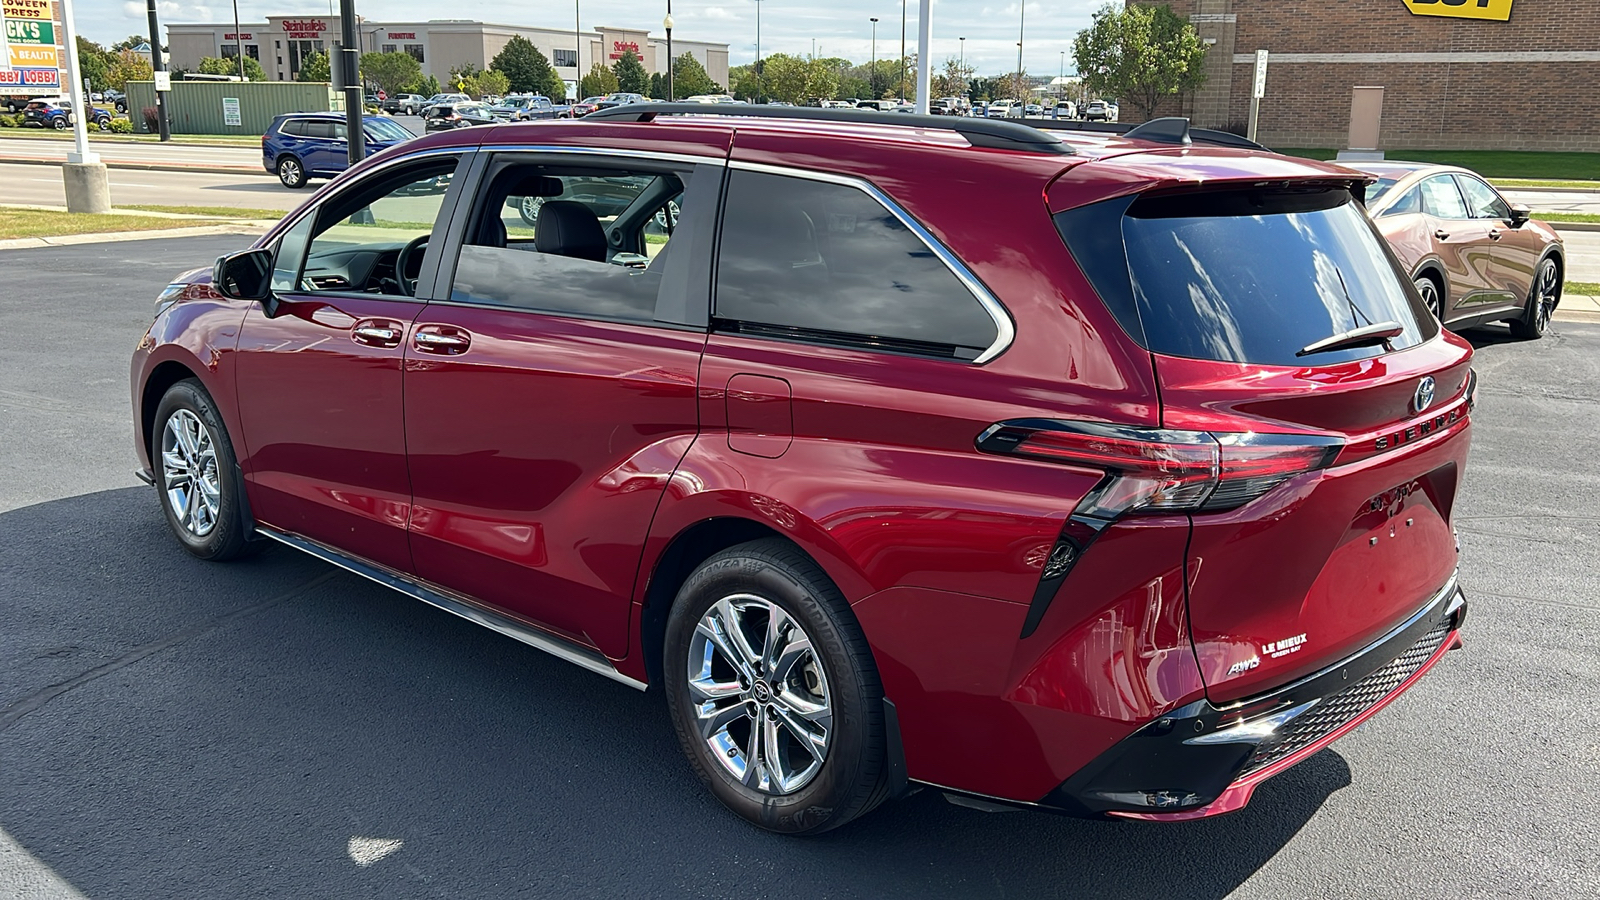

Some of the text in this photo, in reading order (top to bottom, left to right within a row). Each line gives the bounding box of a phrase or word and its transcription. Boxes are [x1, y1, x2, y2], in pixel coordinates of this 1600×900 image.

[3, 8, 41, 17] PRESS
[282, 19, 327, 31] Steinhafels
[19, 50, 55, 60] BEAUTY
[0, 71, 56, 83] BBY LOBBY
[1375, 411, 1459, 449] SIENNA
[1262, 633, 1308, 655] LE MIEUX
[1271, 645, 1301, 658] GREEN BAY
[1227, 655, 1261, 675] AWD
